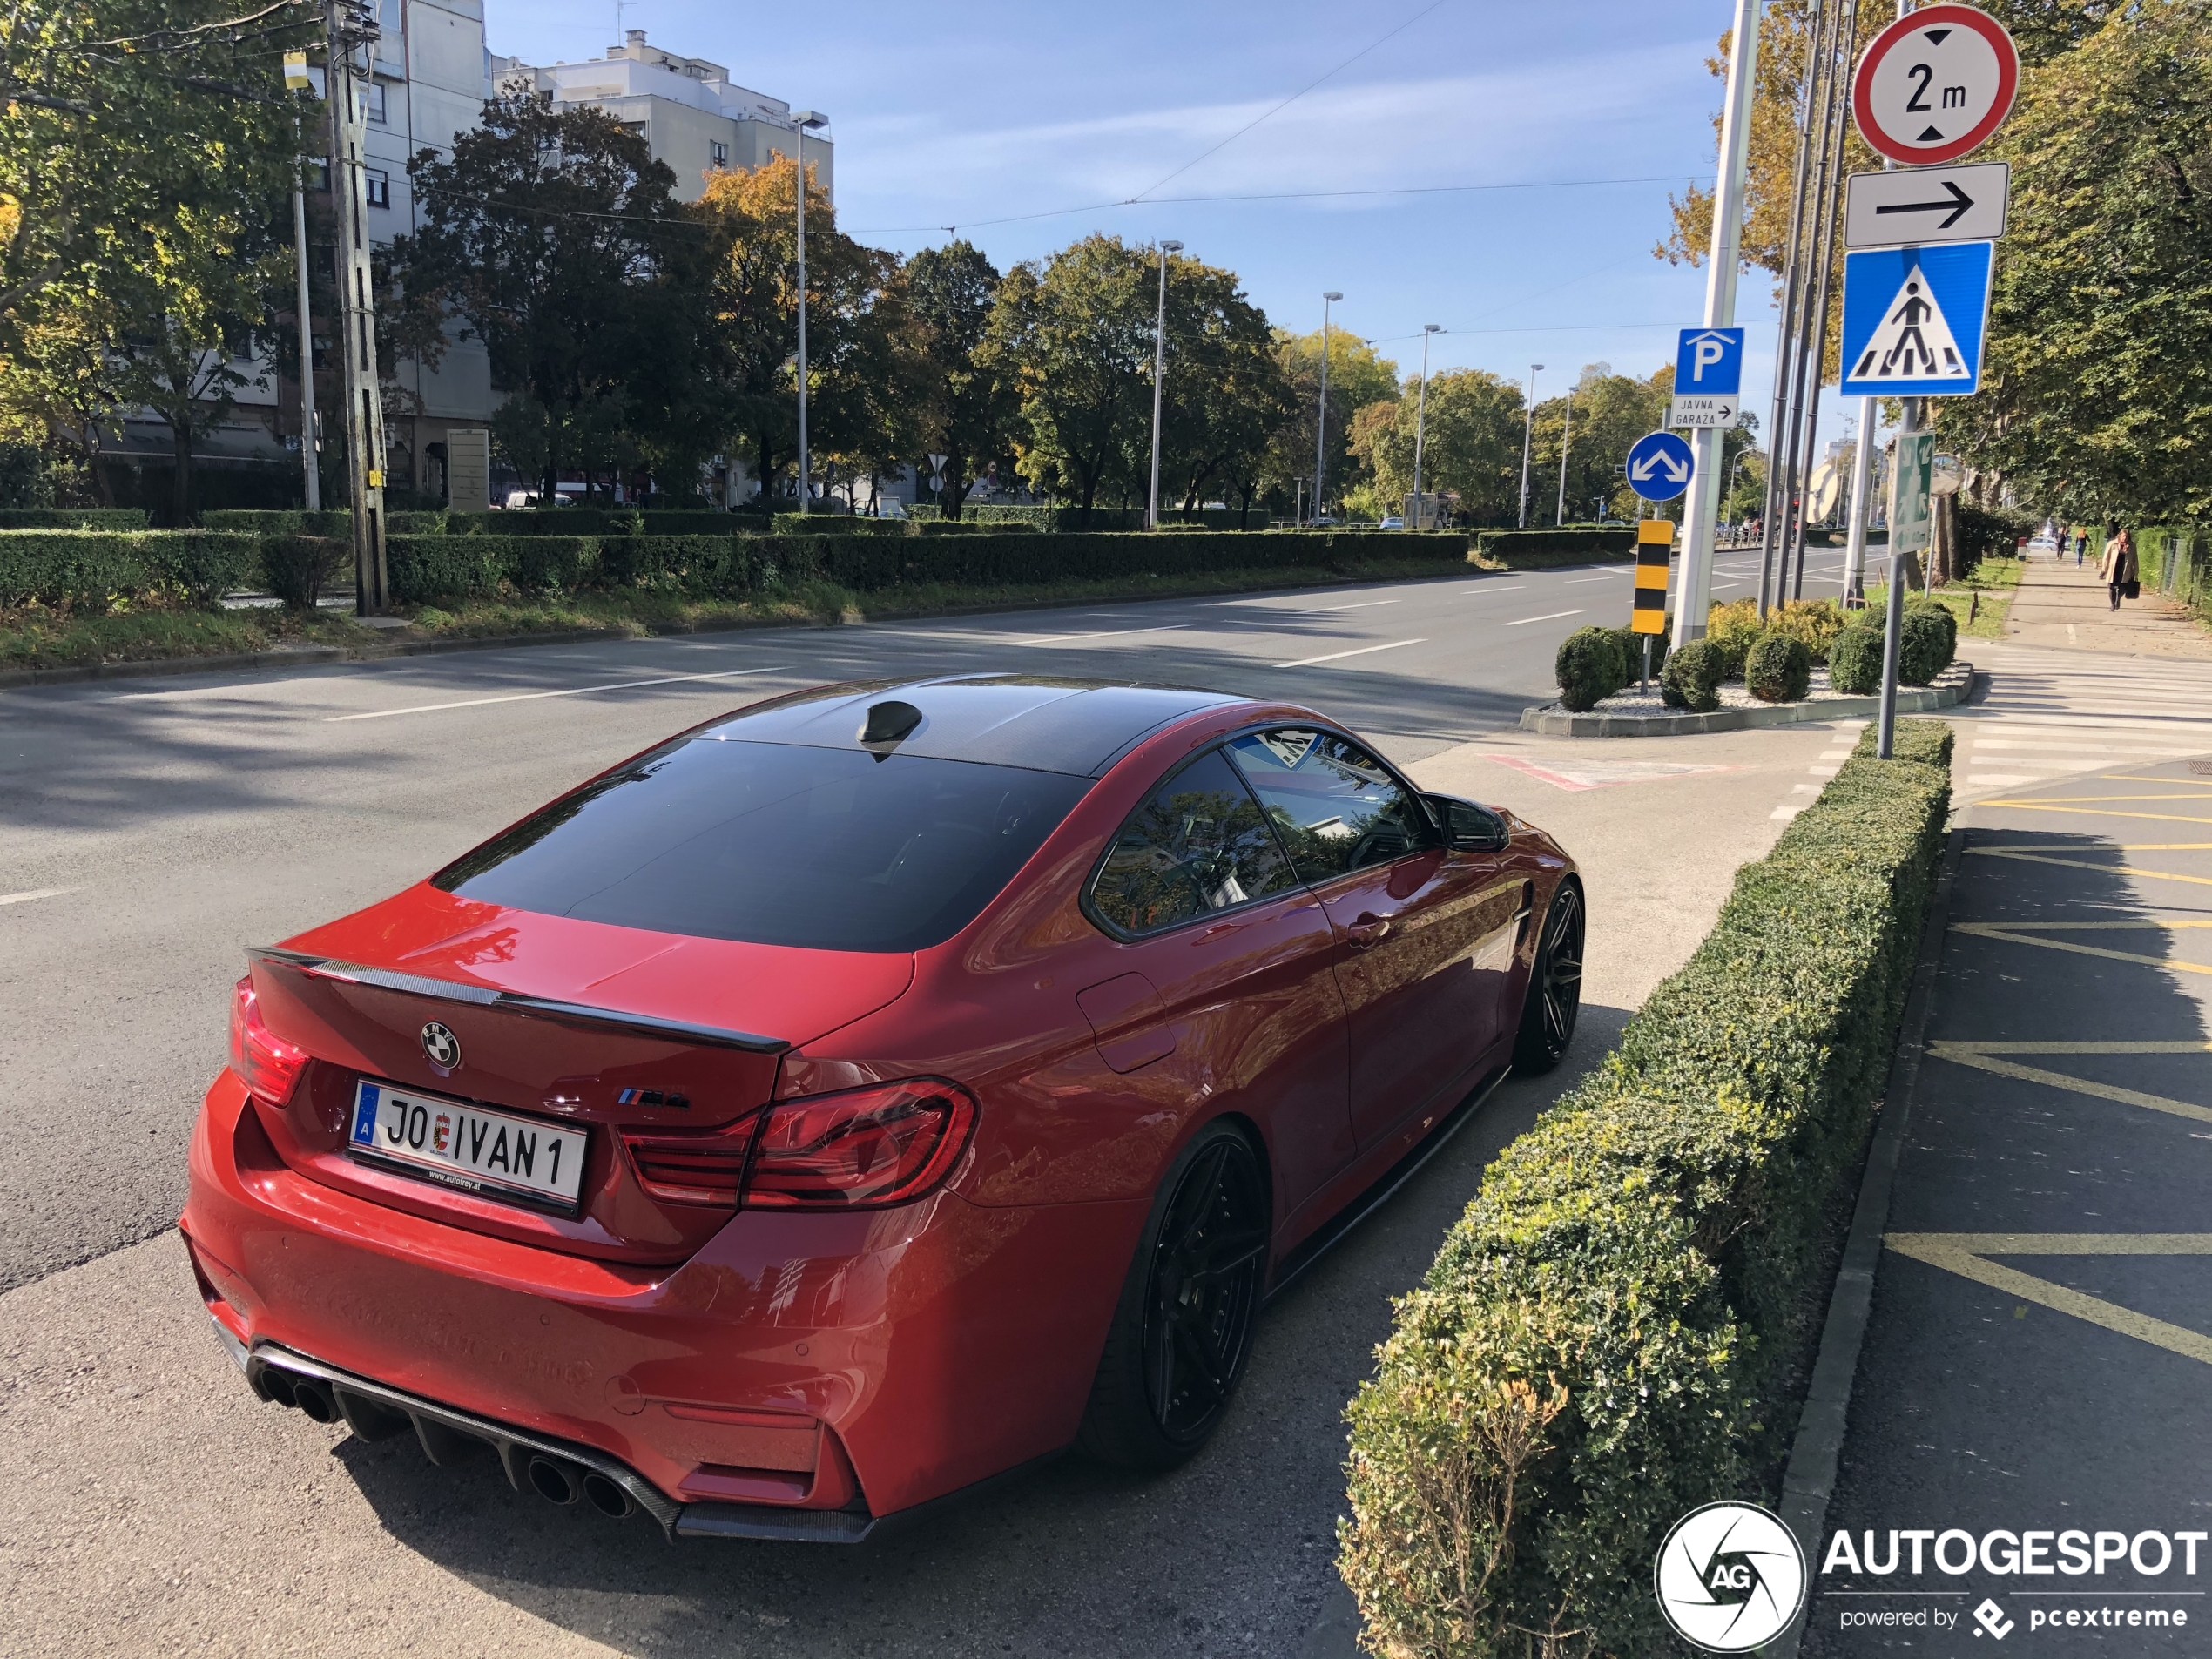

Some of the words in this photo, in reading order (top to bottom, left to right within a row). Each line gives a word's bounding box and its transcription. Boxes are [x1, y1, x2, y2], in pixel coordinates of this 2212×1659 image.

[1905, 63, 1932, 113] 2
[1942, 85, 1966, 109] m
[1693, 341, 1723, 381] P
[1680, 400, 1714, 410] JAVNA
[1676, 412, 1715, 425] GARAŽA
[422, 1024, 454, 1042] BMW
[360, 1122, 369, 1136] A
[388, 1099, 428, 1150] JO
[454, 1116, 537, 1178] IVAN
[548, 1138, 563, 1184] 1
[428, 1170, 481, 1190] www.autofrey.at
